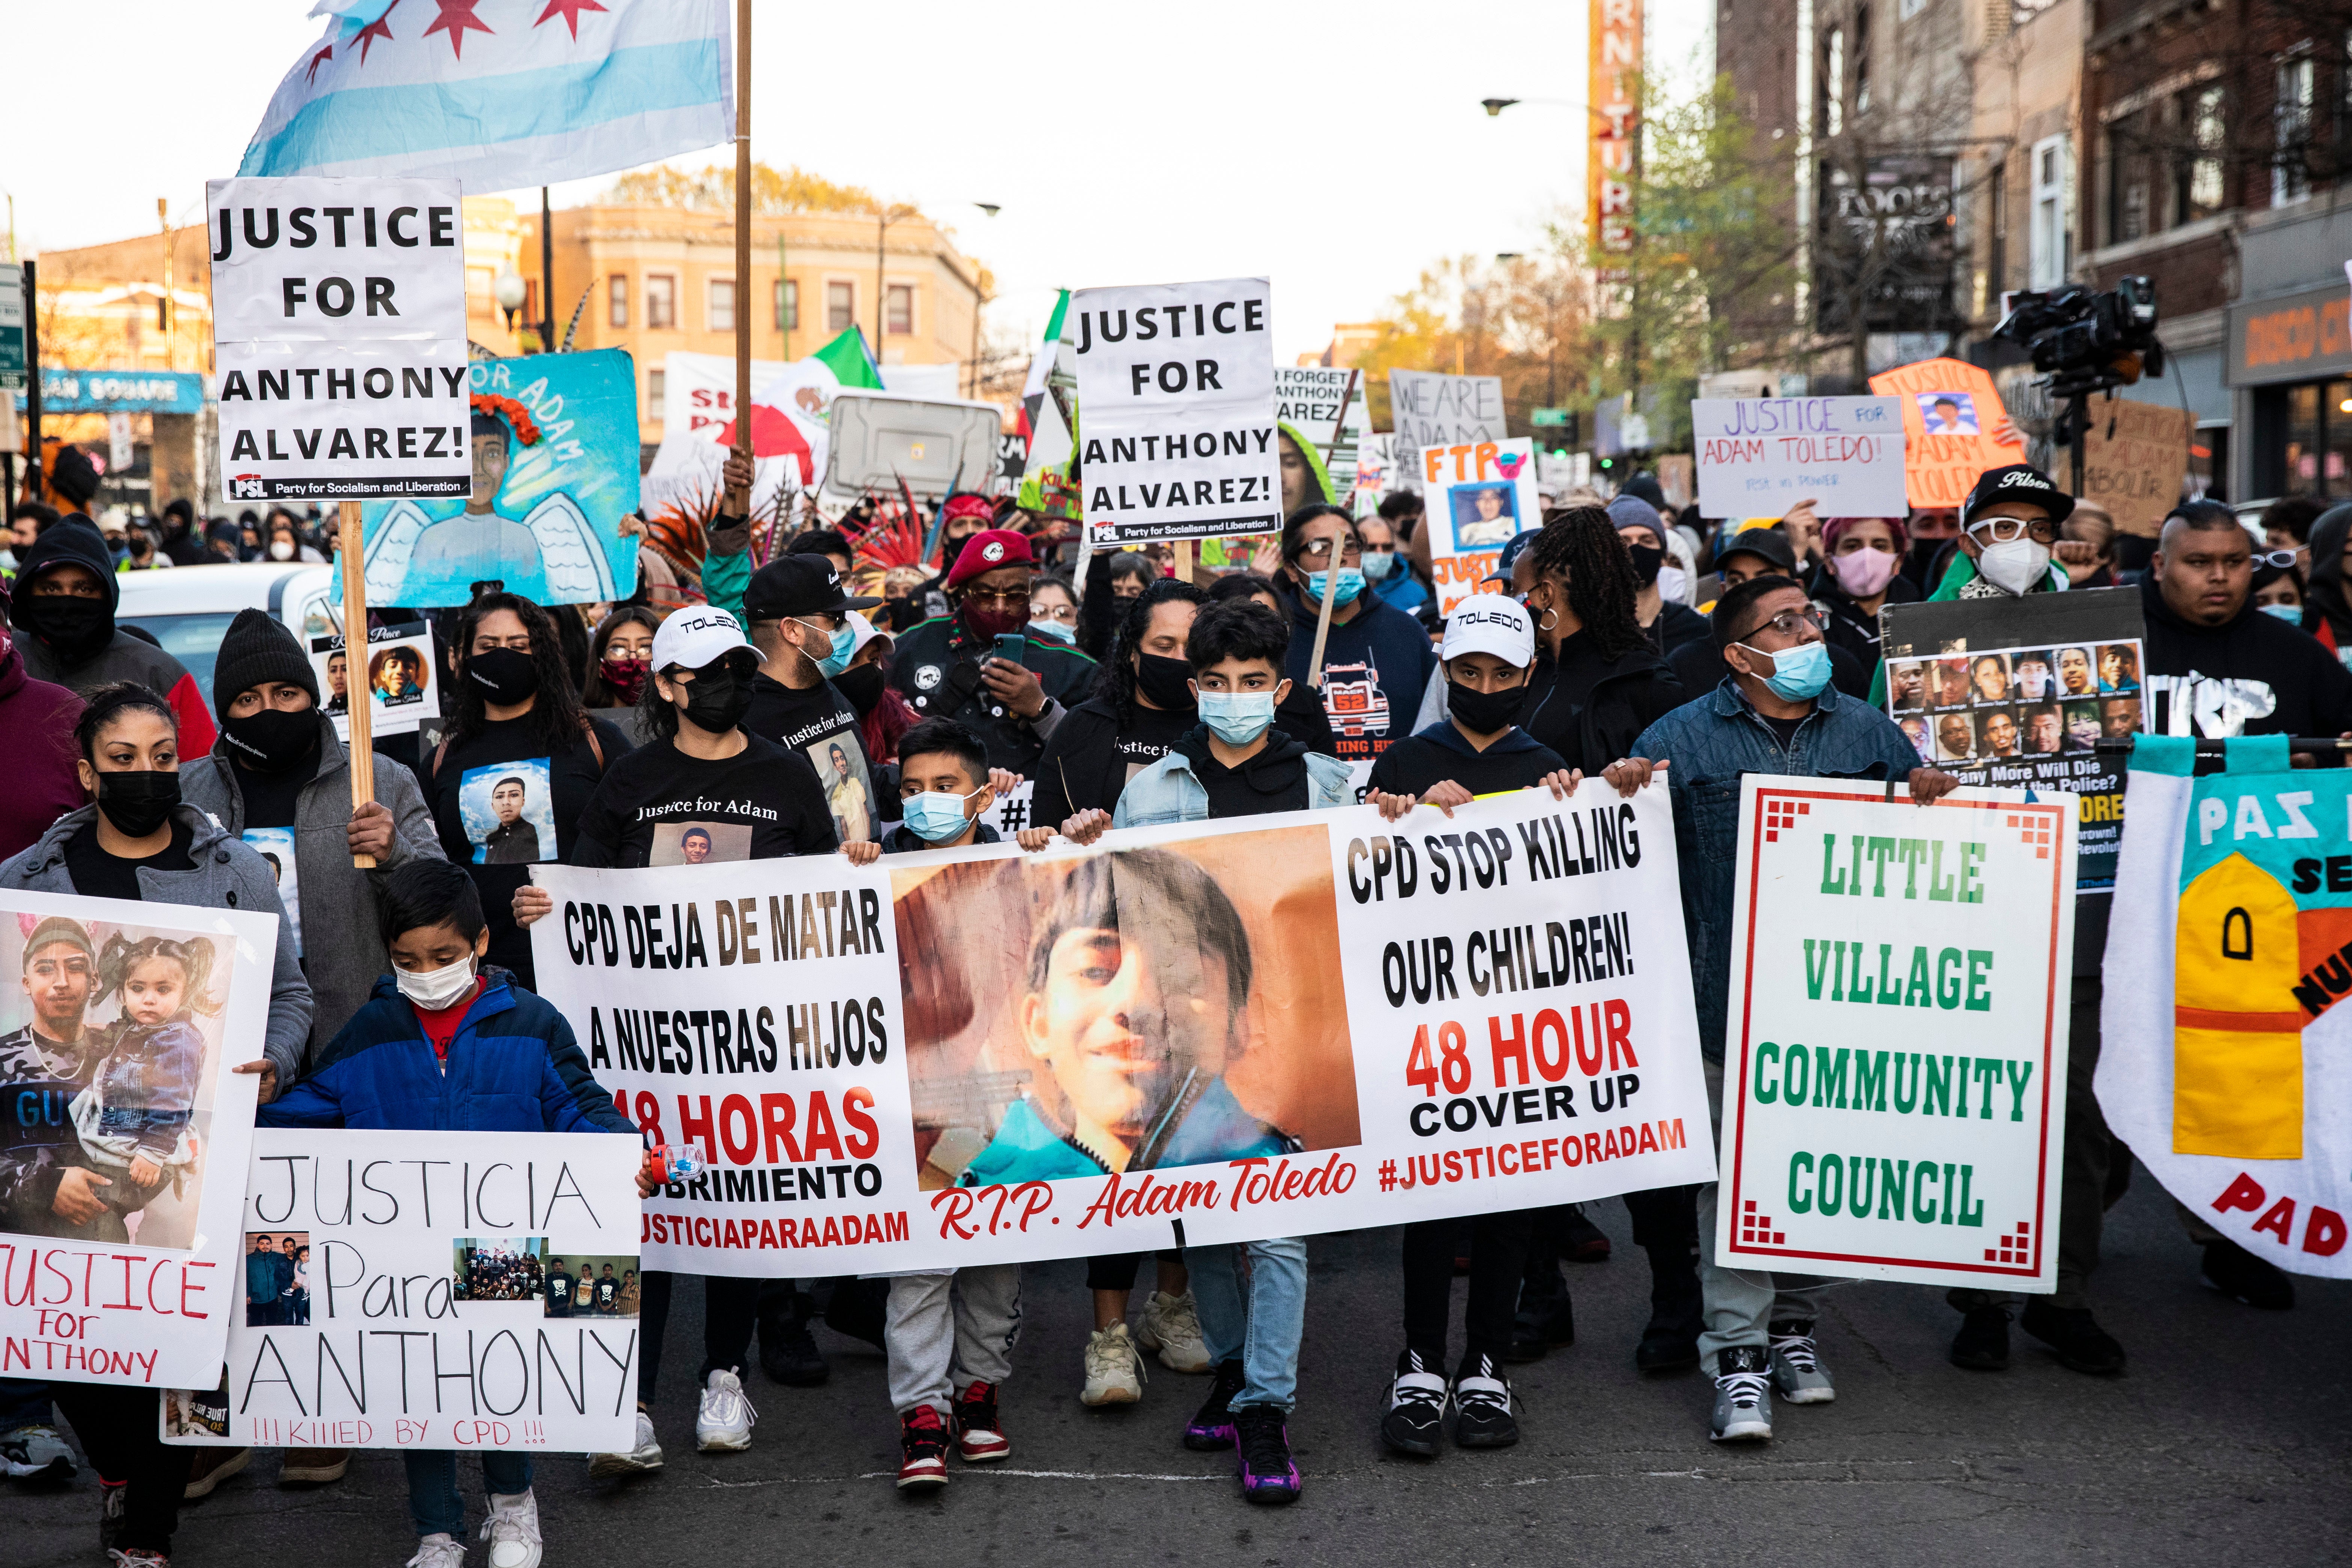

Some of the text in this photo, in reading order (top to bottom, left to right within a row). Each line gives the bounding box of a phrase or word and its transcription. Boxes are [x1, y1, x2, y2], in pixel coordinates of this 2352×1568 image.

[214, 207, 455, 261] JUSTICE
[283, 277, 400, 317] FOR
[1076, 299, 1264, 354] JUSTICE
[89, 378, 178, 401] SQUARE
[221, 367, 467, 401] ANTHONY
[1131, 359, 1223, 396] FOR
[1276, 386, 1350, 400] ANTHONY
[1284, 371, 1348, 384] FORGET
[1884, 364, 1983, 396] JUSTICE
[1277, 402, 1339, 421] AREZ
[1392, 377, 1430, 416] WE
[1432, 378, 1500, 421] ARE
[1725, 398, 1887, 436] JUSTICE FOR
[519, 377, 584, 461] ADAM
[230, 426, 463, 461] ALVAREZ!
[1084, 428, 1273, 465] ANTHONY
[1703, 436, 1882, 466] ADAM TOLEDO!
[1916, 434, 1987, 464] ADAM
[1426, 442, 1498, 484] FTP
[1998, 471, 2051, 491] Pilsen
[235, 481, 268, 498] PSL
[276, 481, 460, 495] Party for Socialism and Liberation
[1090, 476, 1269, 513] ALVAREZ!
[1907, 466, 1989, 501] TOLED
[1094, 526, 1119, 541] PSL
[1125, 520, 1268, 537] Party for Socialism and Liberation
[1434, 553, 1502, 584] JUST
[680, 616, 741, 633] TOLEDO
[1458, 611, 1522, 632] TOLEDO
[1336, 695, 1365, 710] 52
[781, 710, 855, 750] Justice for Adam
[1991, 765, 2032, 781] More
[2037, 760, 2070, 778] Will
[2073, 760, 2101, 776] Die
[2029, 780, 2056, 792] the
[2059, 774, 2118, 793] Police?
[636, 796, 778, 821] Justice for Adam
[1348, 802, 1642, 904] CPD STOP KILLING
[1821, 833, 1986, 904] LITTLE
[564, 888, 884, 970] CPD DEJA DE MATAR
[1382, 911, 1635, 1008] OUR CHILDREN!
[1803, 938, 1994, 1012] VILLAGE
[591, 996, 888, 1075] A NUESTRAS HIJOS
[1406, 998, 1639, 1098] 48 HOUR
[1754, 1041, 2033, 1122] COMMUNITY
[1410, 1073, 1640, 1137] COVER UP
[677, 1086, 880, 1166] HORAS
[1378, 1118, 1687, 1193] #JUSTICEFORADAM
[256, 1155, 602, 1230] JUSTICIA
[930, 1152, 1357, 1241] R.I.P. Adam Toledo
[1788, 1150, 1984, 1227] COUNCIL
[2211, 1171, 2348, 1257] PAD
[0, 1244, 216, 1319] USTICE
[321, 1239, 458, 1319] Para
[240, 1328, 636, 1417] ANTHONY
[396, 1419, 429, 1444] BY
[453, 1420, 511, 1446] CPD
